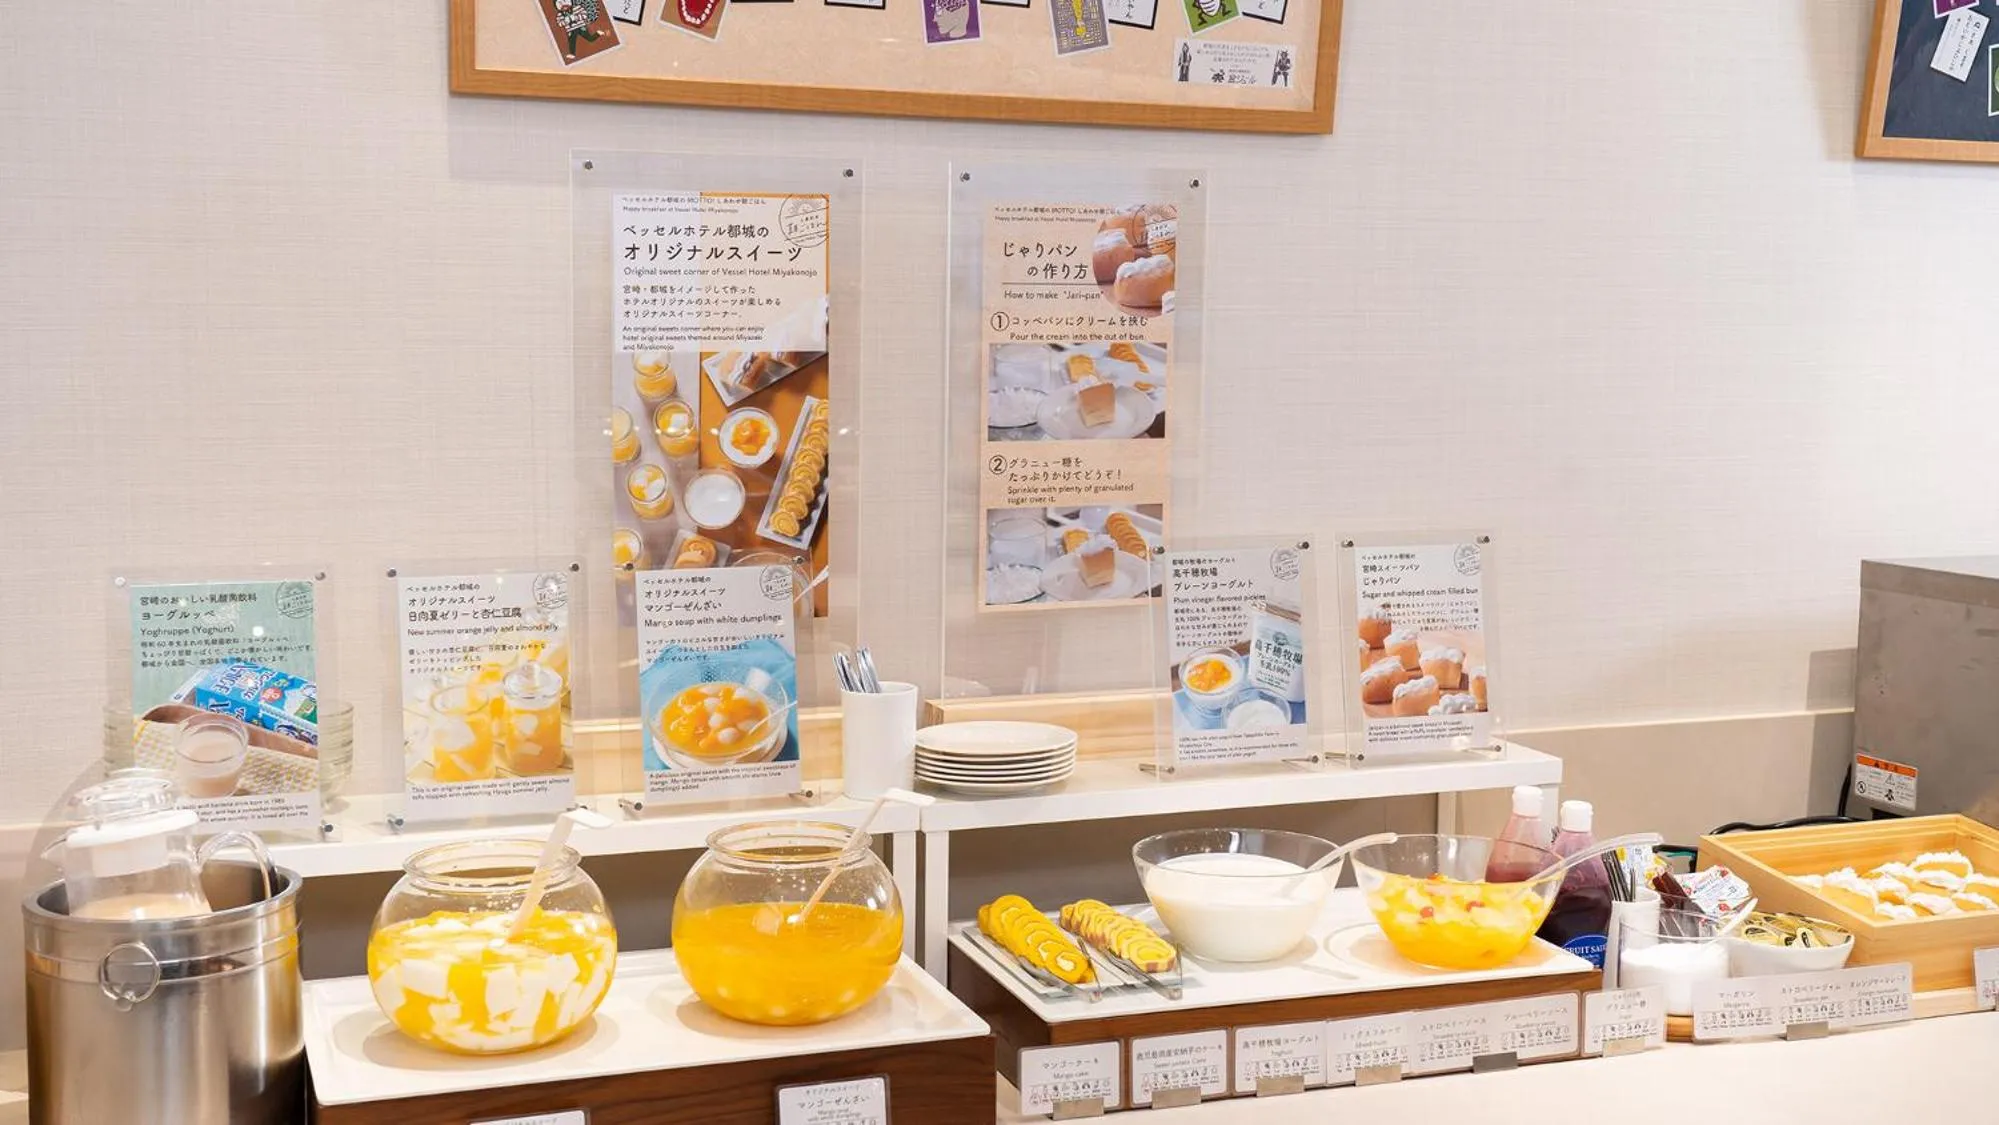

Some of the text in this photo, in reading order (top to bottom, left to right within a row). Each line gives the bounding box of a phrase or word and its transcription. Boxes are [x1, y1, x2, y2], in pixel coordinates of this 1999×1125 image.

[623, 224, 770, 239] ベッセルホテル都城の
[624, 242, 802, 262] オリジナルスイーツ
[1004, 241, 1078, 259] じゃりパン
[624, 267, 818, 278] Original sweet corner of Vessel Hotel Miyakonojo
[1026, 263, 1089, 280] の作り方
[1004, 290, 1024, 300] How
[1026, 291, 1034, 300] to
[1036, 292, 1059, 300] make
[623, 298, 781, 306] ホテルオリジナルのスイーツが楽しめる
[1012, 316, 1148, 328] コッペパンにクリームを挟む
[634, 326, 658, 334] original
[1010, 333, 1029, 341] Pour
[1030, 332, 1044, 341] the
[1072, 332, 1088, 341] into
[1089, 332, 1102, 341] the
[1118, 332, 1128, 341] of
[636, 344, 674, 352] Miyakonojo
[1008, 457, 1083, 469] グラニュー糖を
[1008, 484, 1134, 496] Sprinkle with plenty of granulated
[1008, 496, 1028, 505] sugar
[1030, 496, 1047, 504] over
[1172, 567, 1218, 578] 高千穂牧場
[1362, 564, 1420, 574] 宮崎スイーツパン
[643, 576, 712, 585] ベッセルホテル都城の
[1174, 580, 1254, 592] プレーンヨーグルト
[1362, 576, 1402, 586] じゃりパン
[407, 584, 480, 592] ベッセルホテル都城の
[644, 587, 726, 598] オリジナルスイーツ
[1362, 587, 1478, 600] Sugar and whipped cream filled bun
[408, 595, 496, 606] オリジナルスイーツ
[1173, 594, 1266, 605] Plum vinegar flavored pickles
[644, 600, 723, 612] マンゴーぜんざい
[140, 609, 216, 622] ヨーグルッペ
[408, 606, 522, 622] 日向夏ゼリーと杏仁豆腐
[675, 618, 694, 627] soup
[698, 616, 714, 626] with
[716, 614, 738, 624] white
[740, 613, 782, 624] dumplings
[140, 624, 235, 638] Yoghruppe (Yoghurt)
[408, 628, 424, 636] New
[456, 627, 482, 636] orange
[483, 626, 498, 636] jelly
[500, 625, 514, 634] and
[516, 624, 542, 632] almond
[544, 622, 559, 633] jelly
